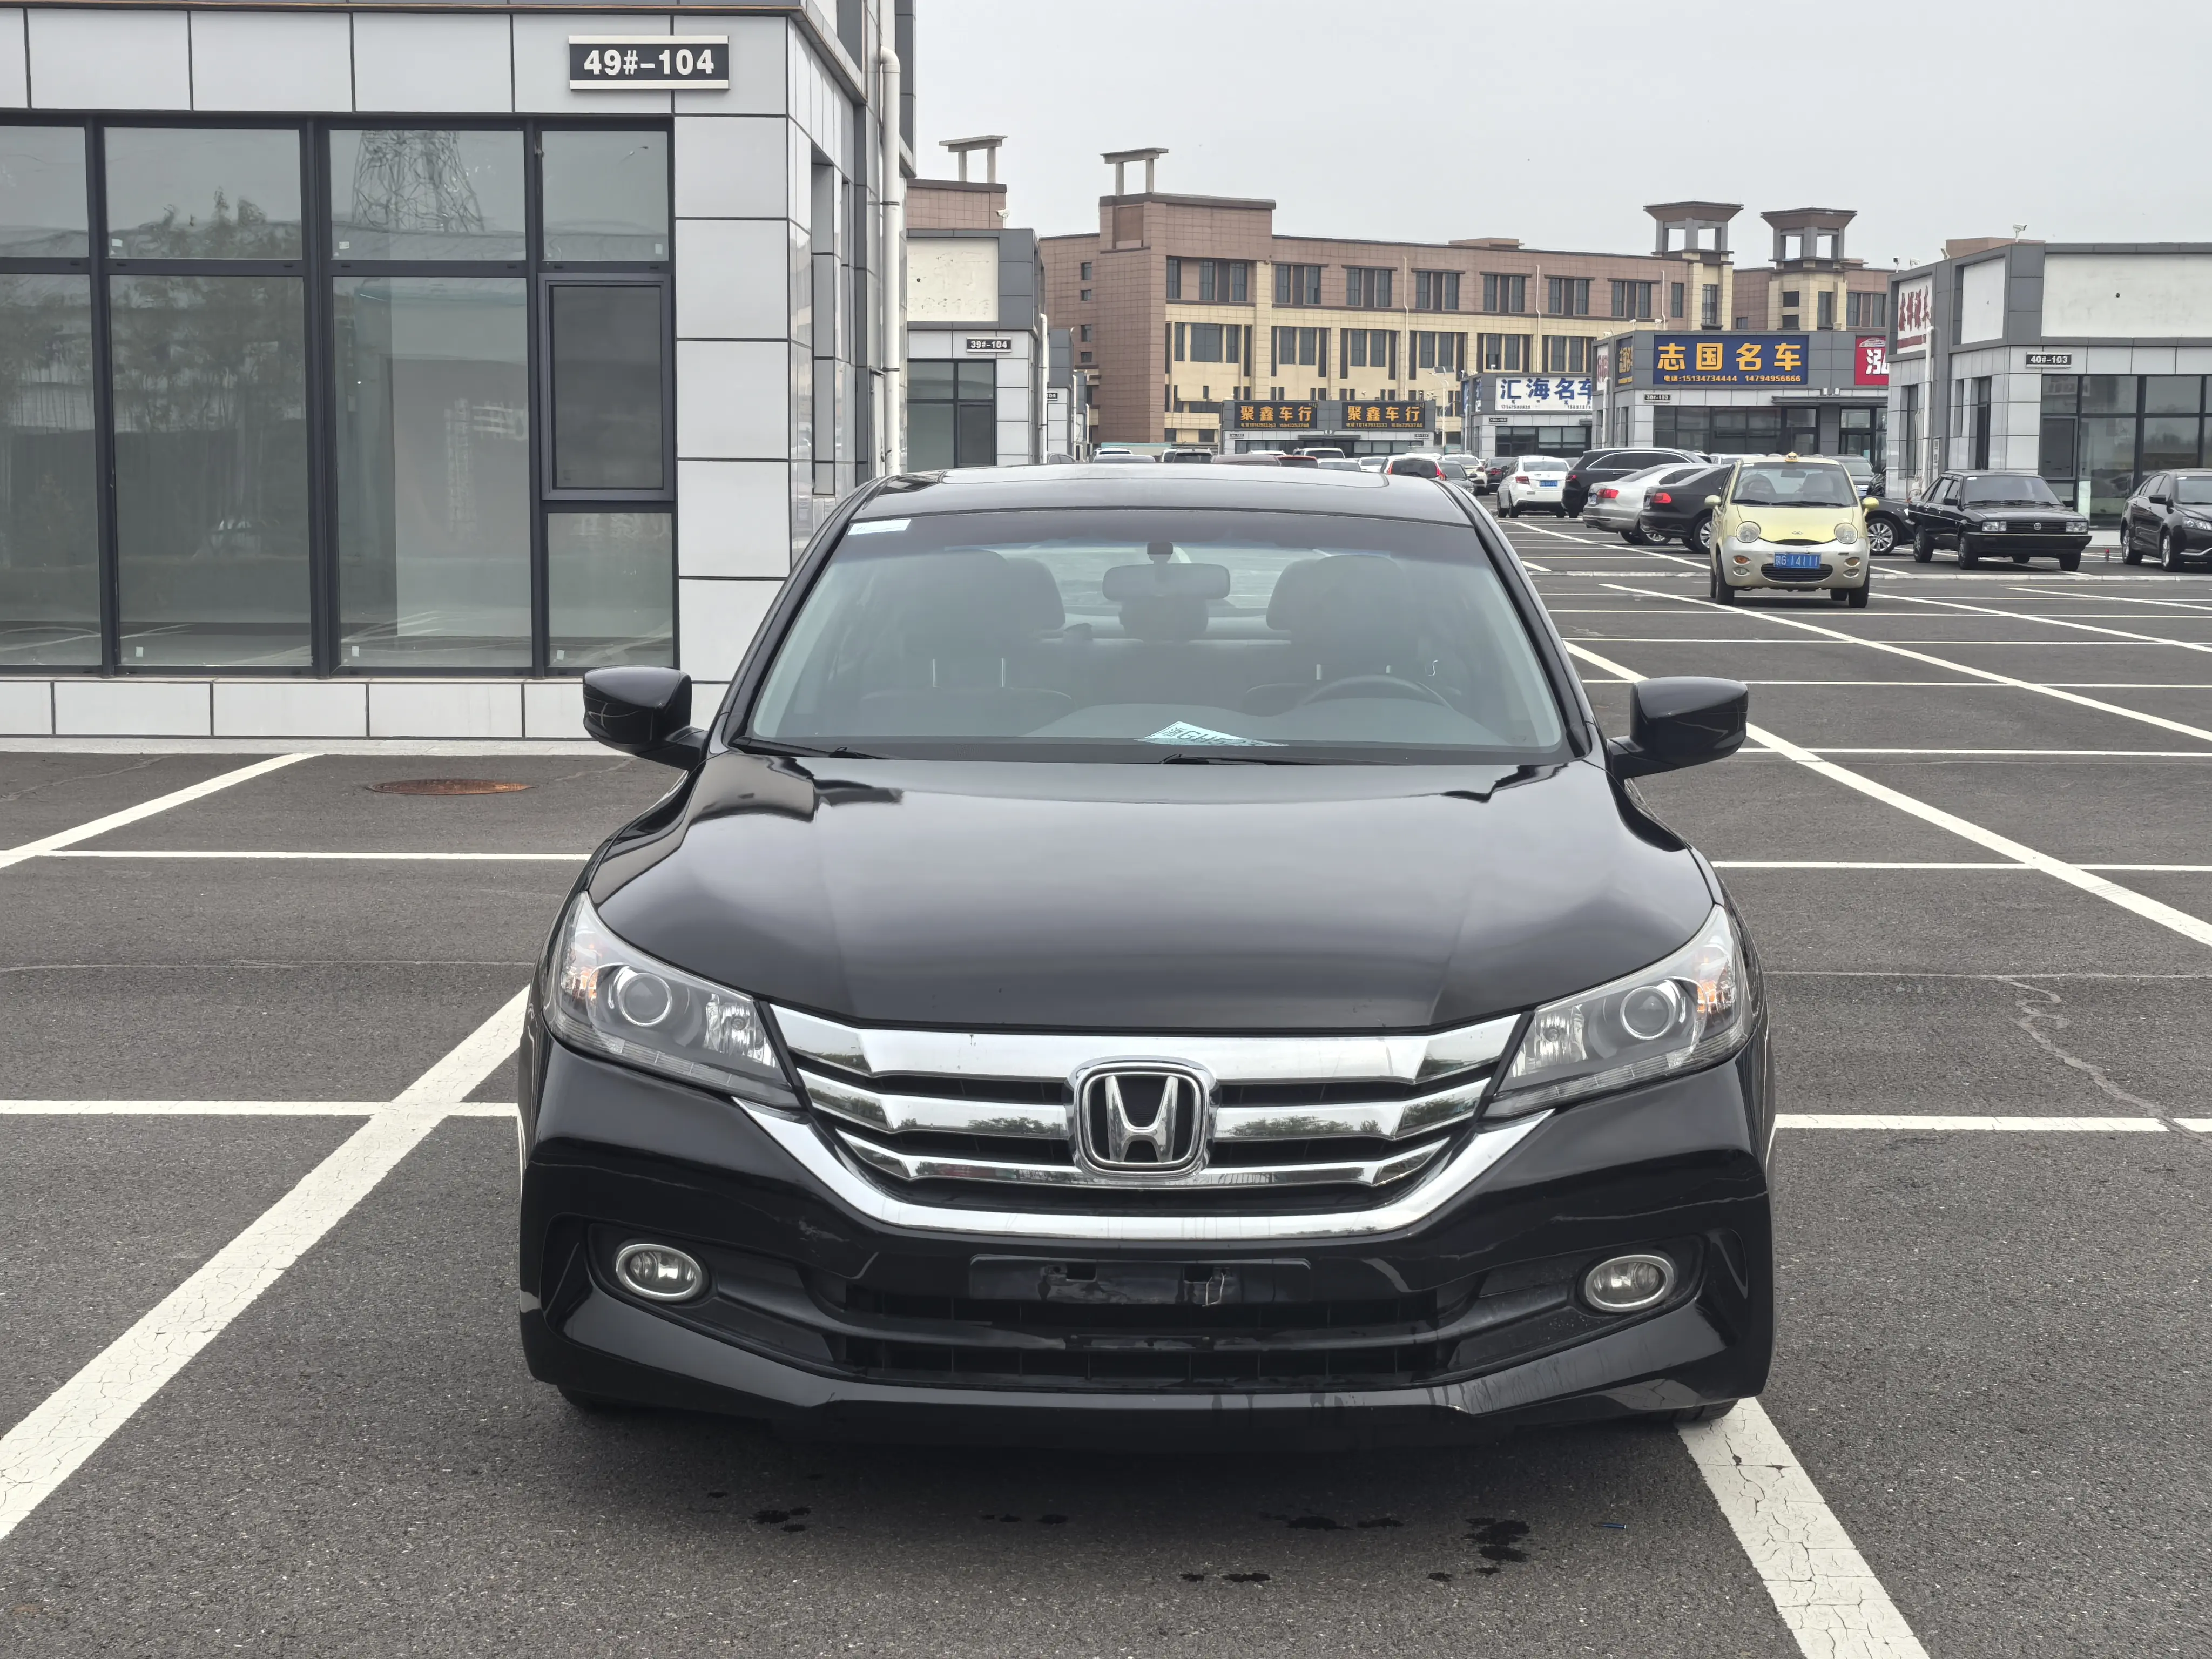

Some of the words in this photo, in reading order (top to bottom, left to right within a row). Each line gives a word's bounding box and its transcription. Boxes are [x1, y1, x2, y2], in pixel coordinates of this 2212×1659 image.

[584, 49, 714, 76] 49#-104
[970, 340, 1008, 348] 39#-104
[1657, 343, 1802, 371] 志国名车
[2031, 355, 2068, 363] 40#-103
[1240, 406, 1312, 421] 聚鑫车行
[1347, 406, 1420, 421] 聚鑫车行
